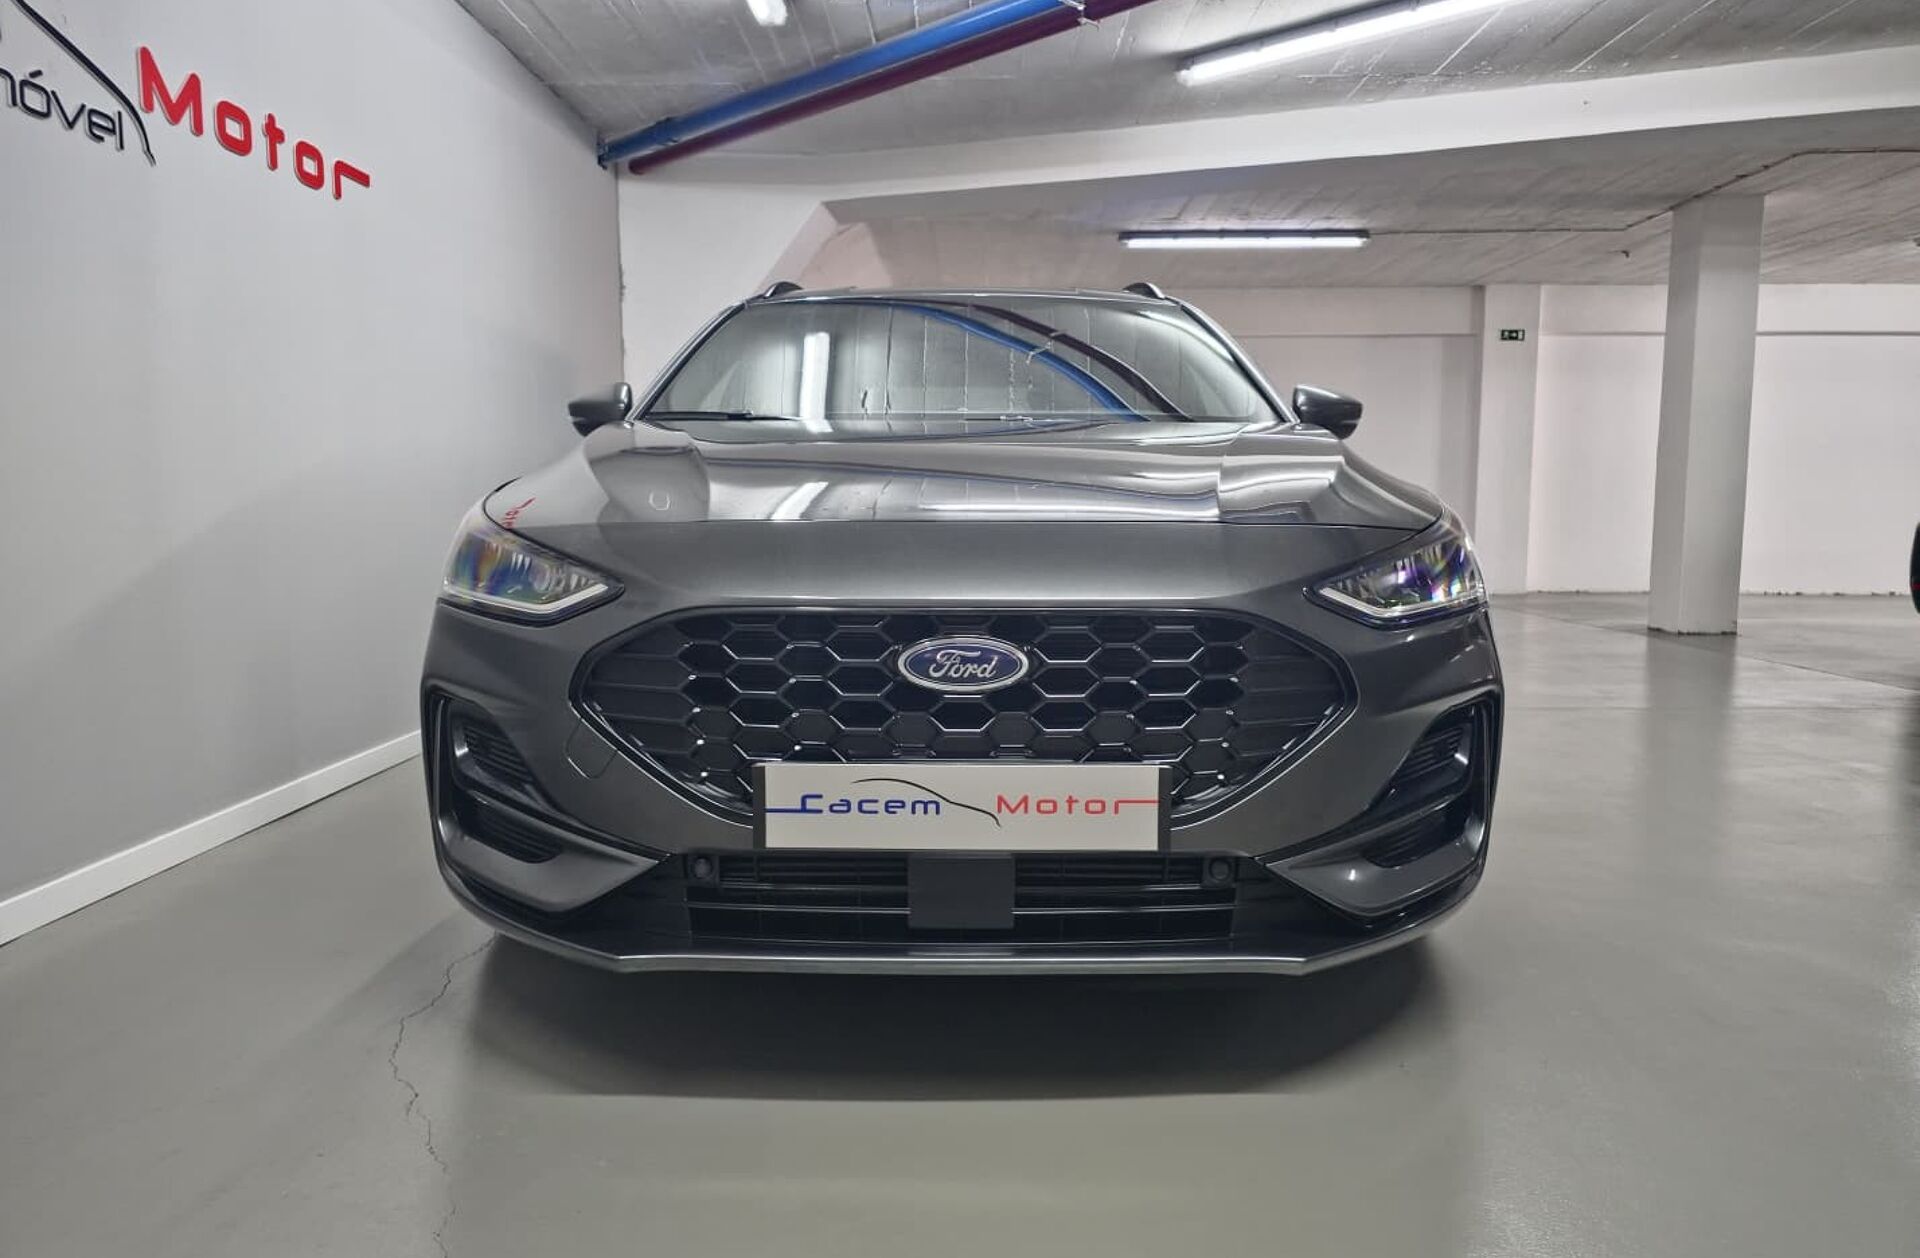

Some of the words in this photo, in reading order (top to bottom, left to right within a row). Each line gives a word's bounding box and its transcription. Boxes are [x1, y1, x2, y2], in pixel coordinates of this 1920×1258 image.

[138, 46, 371, 200] Motor
[928, 649, 998, 679] Ford
[766, 794, 940, 816] Cacem
[996, 794, 1158, 816] Motor
